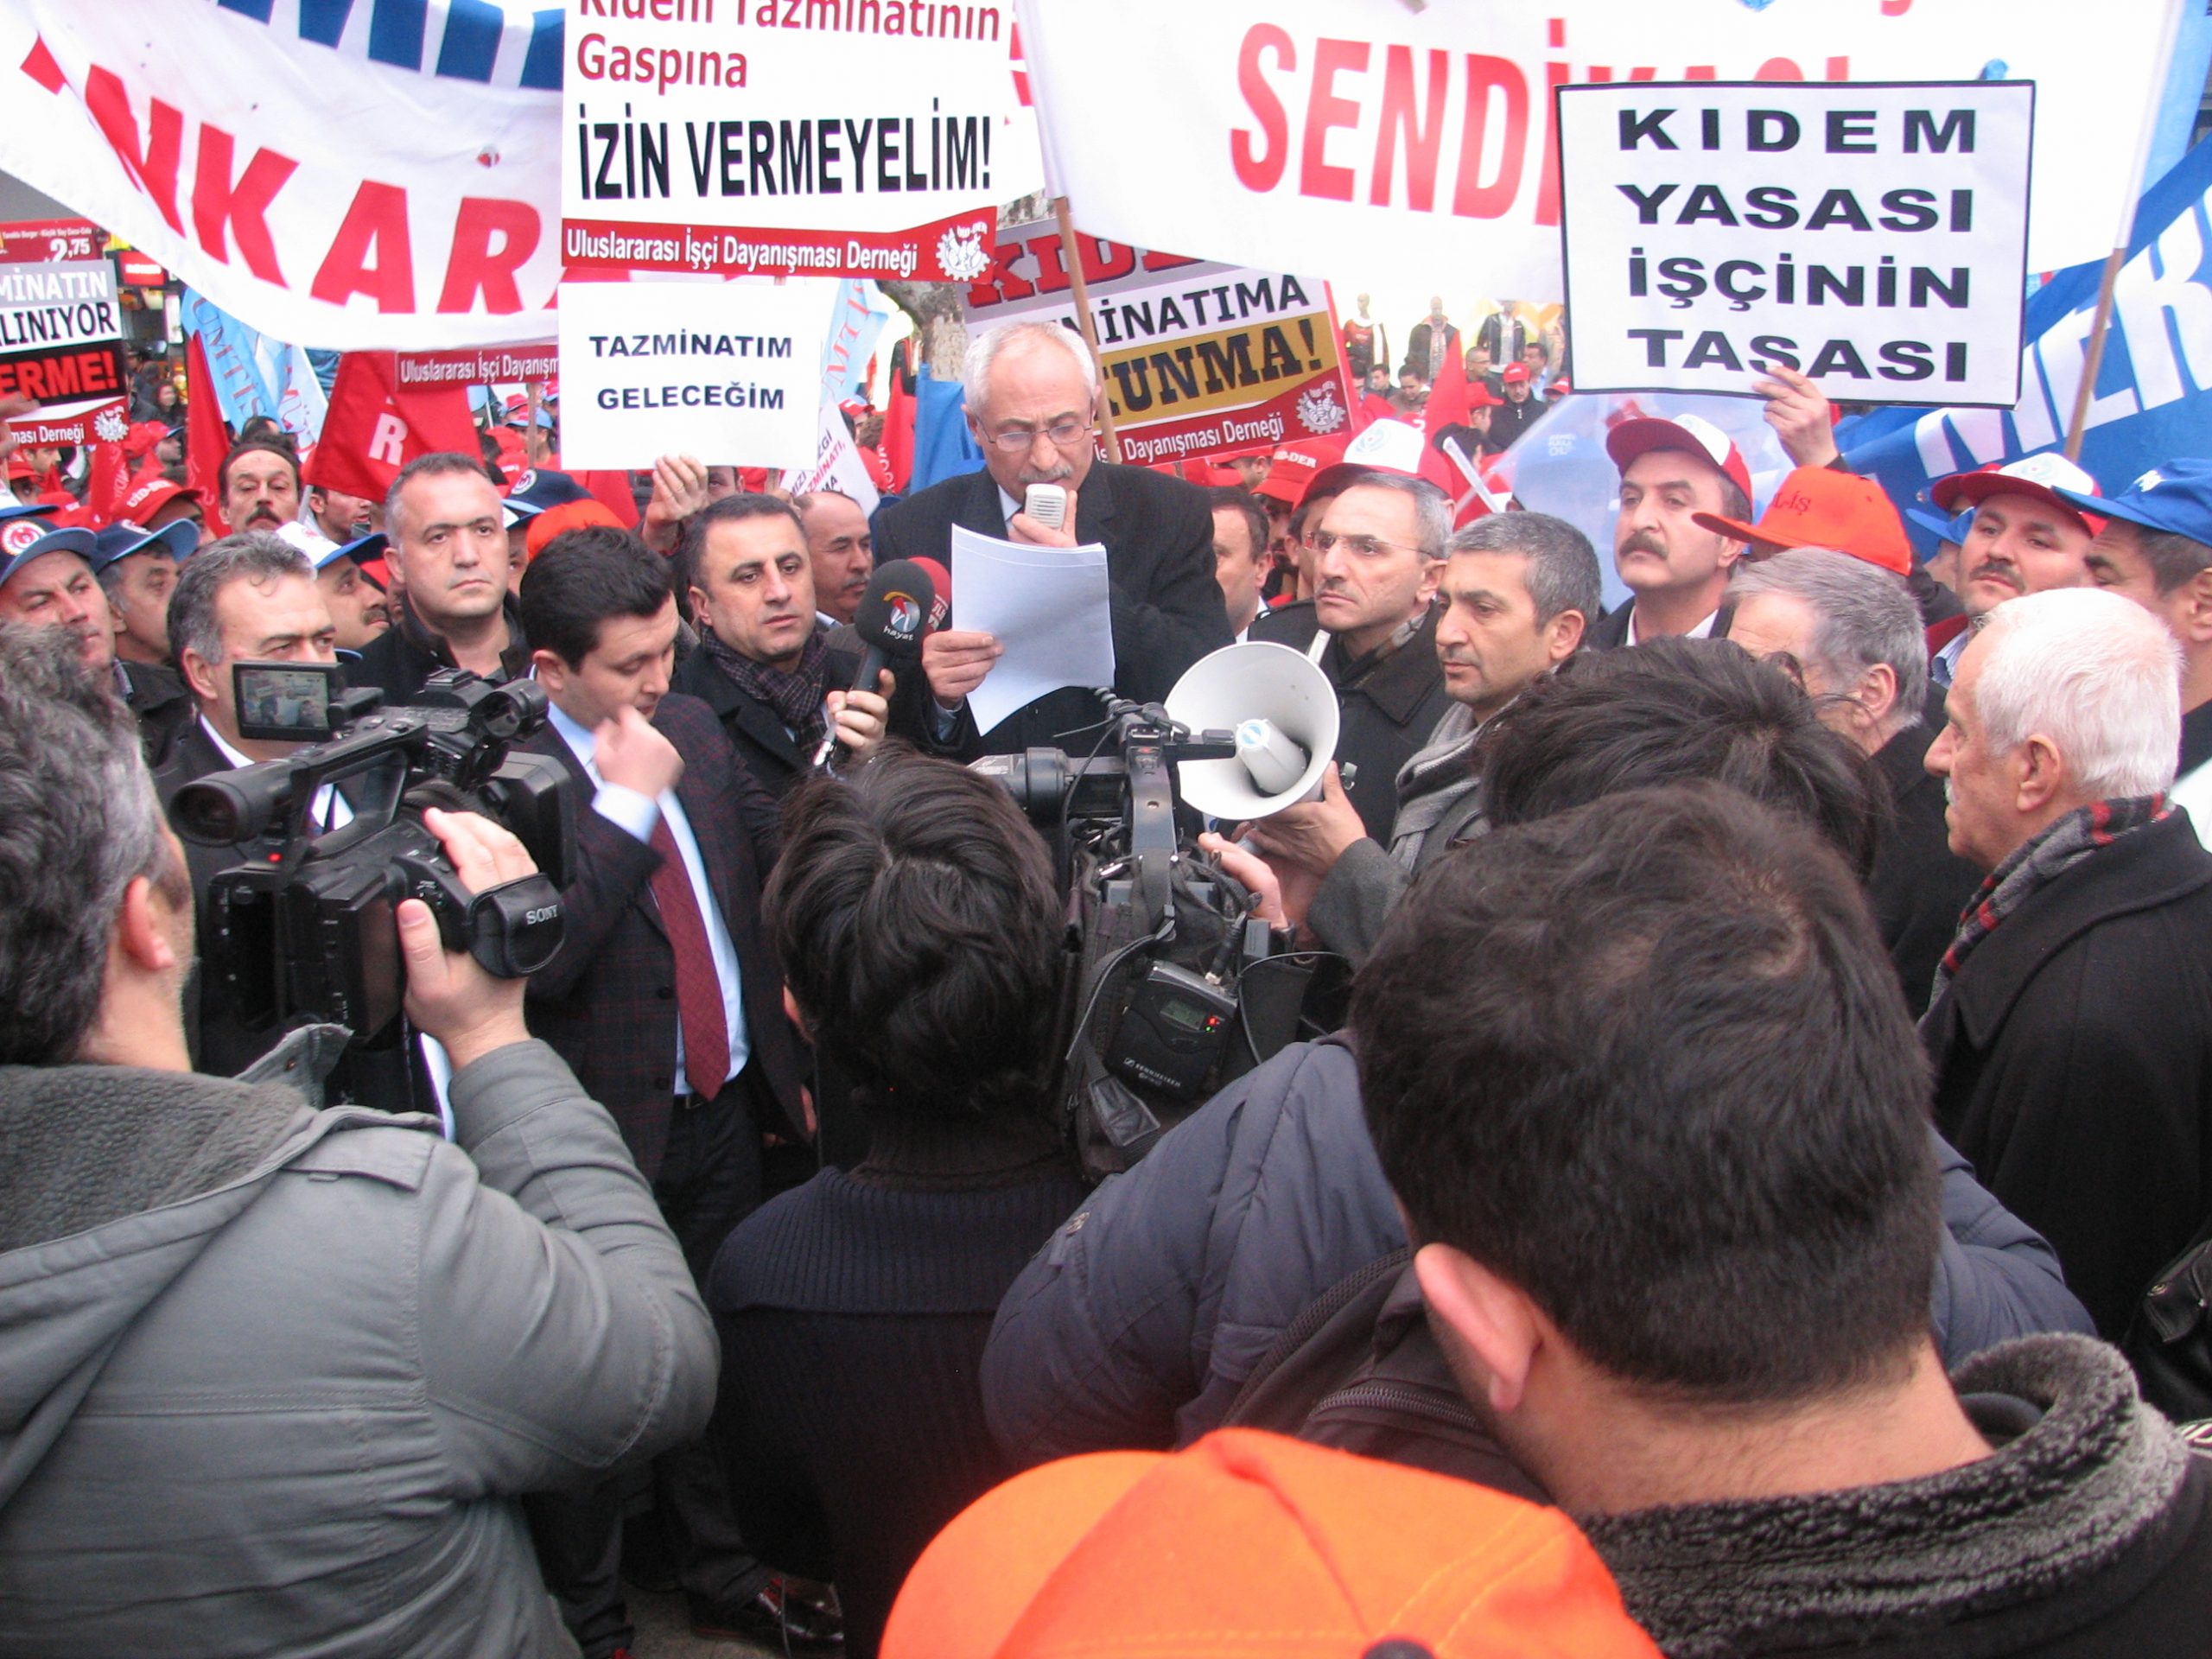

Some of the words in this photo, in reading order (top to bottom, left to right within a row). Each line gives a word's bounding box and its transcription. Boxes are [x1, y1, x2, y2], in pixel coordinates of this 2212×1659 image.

[575, 33, 749, 96] Gaspına
[577, 101, 671, 200] İZİN
[685, 97, 992, 198] VERMEYELİM!
[1617, 108, 1977, 155] KIDEM
[1613, 183, 1974, 233] YASASI
[567, 228, 680, 262] Uluslararası
[685, 227, 718, 270] İşçi
[723, 235, 842, 274] Dayanışması
[846, 241, 918, 278] Derneği
[1628, 246, 1971, 313] İŞÇİNİN
[400, 359, 475, 383] Uluslararası
[478, 351, 499, 384] İşçi
[589, 327, 793, 359] TAZMİNATIM
[1627, 328, 1967, 383] TASASI
[596, 381, 785, 411] GELECEĞİM
[1124, 424, 1221, 461] Dayanışması
[1222, 411, 1285, 444] Derneği
[883, 626, 913, 641] hayat
[525, 904, 557, 925] SONY
